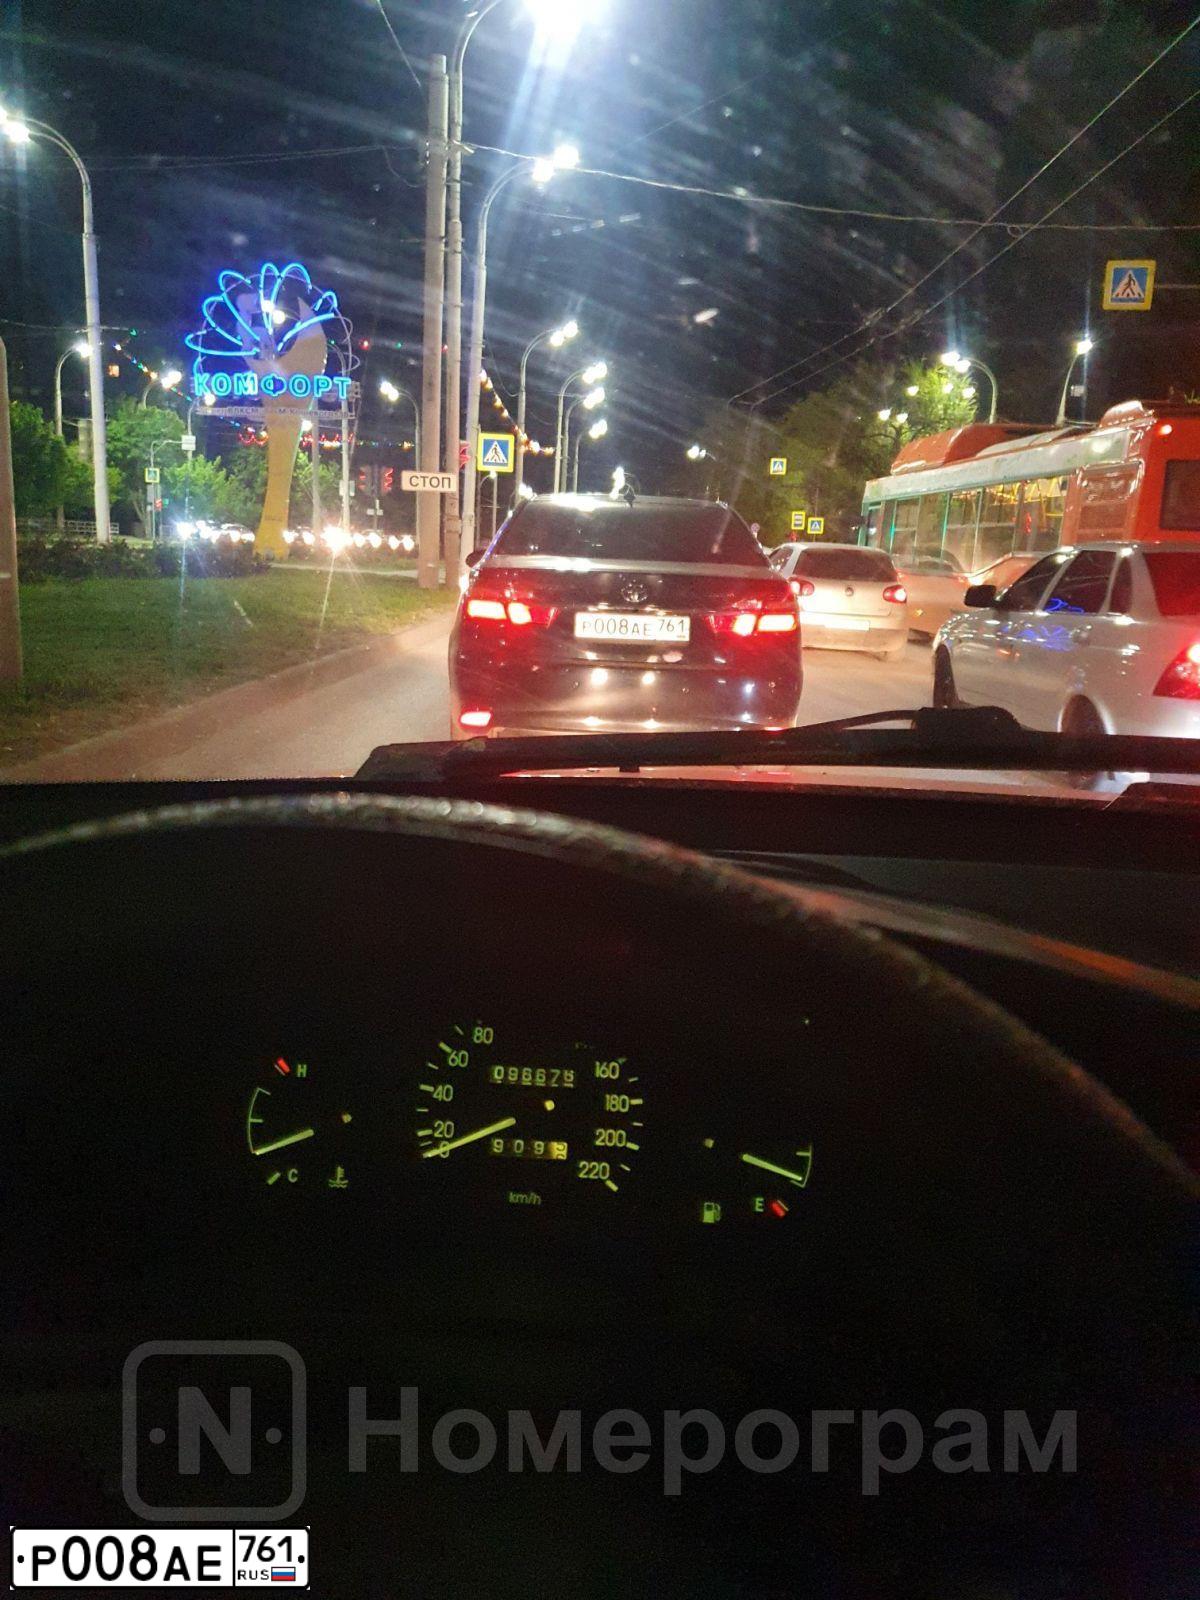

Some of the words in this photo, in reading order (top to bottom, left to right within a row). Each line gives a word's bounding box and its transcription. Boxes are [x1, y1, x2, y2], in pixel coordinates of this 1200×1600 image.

[193, 371, 352, 400] КОМФОРТ
[409, 475, 451, 489] СТОП
[473, 1027, 494, 1044] 80
[449, 1050, 469, 1067] 60
[297, 1064, 307, 1078] H
[594, 1061, 620, 1079] 160
[433, 1084, 454, 1101] 40
[605, 1095, 630, 1113] 180
[433, 1121, 455, 1138] 20
[595, 1129, 627, 1147] 200
[288, 1168, 299, 1183] C
[578, 1161, 611, 1180] 220
[754, 1197, 765, 1213] E
